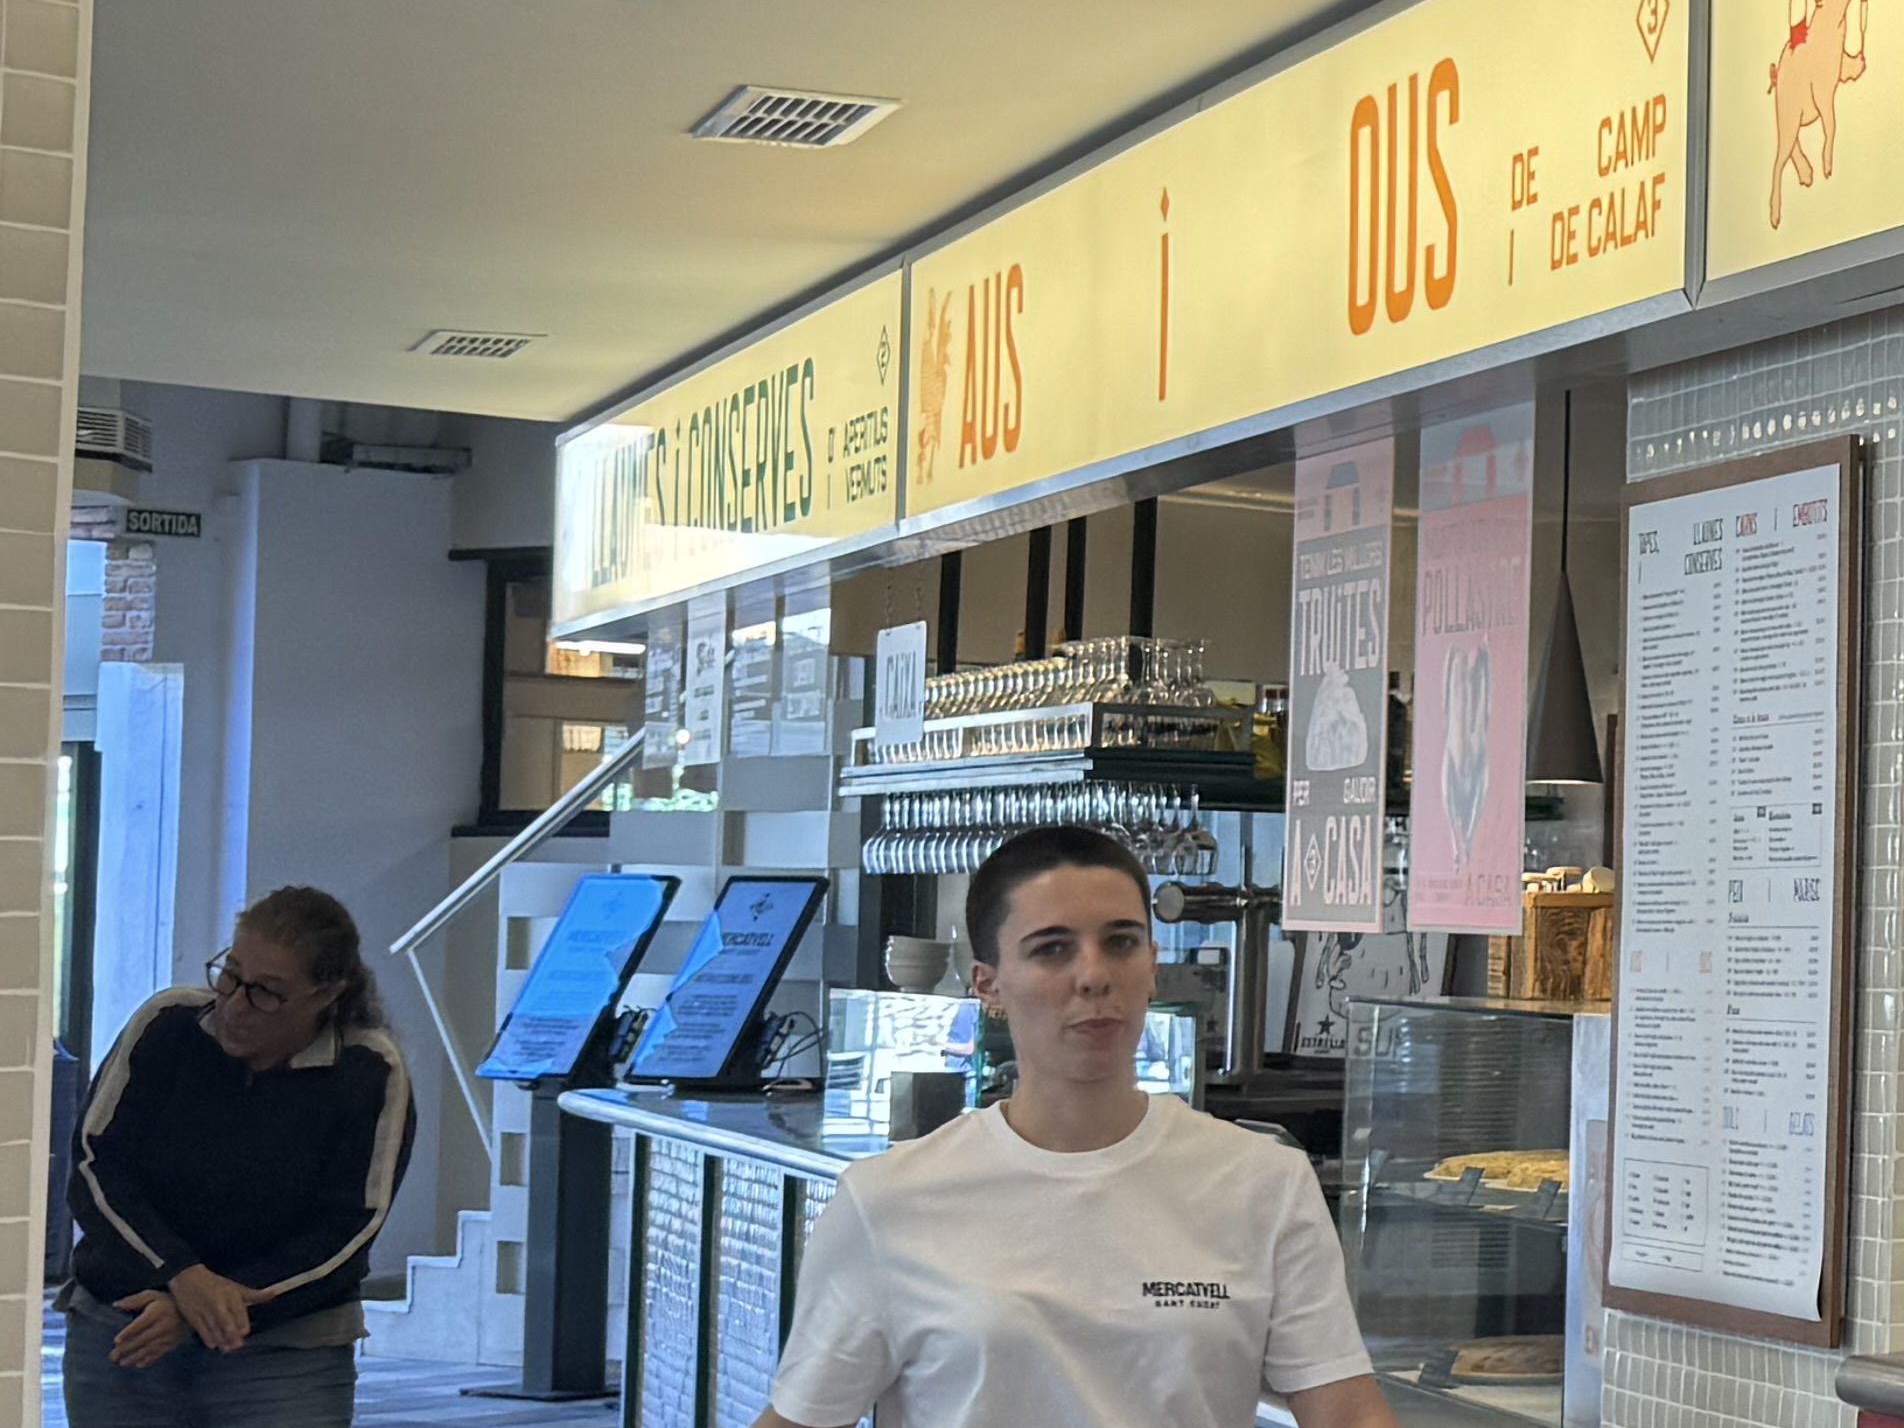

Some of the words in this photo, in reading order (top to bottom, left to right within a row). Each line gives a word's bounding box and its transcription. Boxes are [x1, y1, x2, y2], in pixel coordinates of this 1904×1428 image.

[1511, 146, 1540, 212] DE
[1598, 93, 1667, 178] CAMP
[959, 263, 1023, 469] AUS
[1348, 57, 1460, 336] OUS
[1550, 204, 1580, 271] DE
[1587, 172, 1666, 259] CALAF
[686, 357, 815, 534] CONSERVES
[128, 511, 198, 536] SORTIDA
[1323, 814, 1373, 905] CASA
